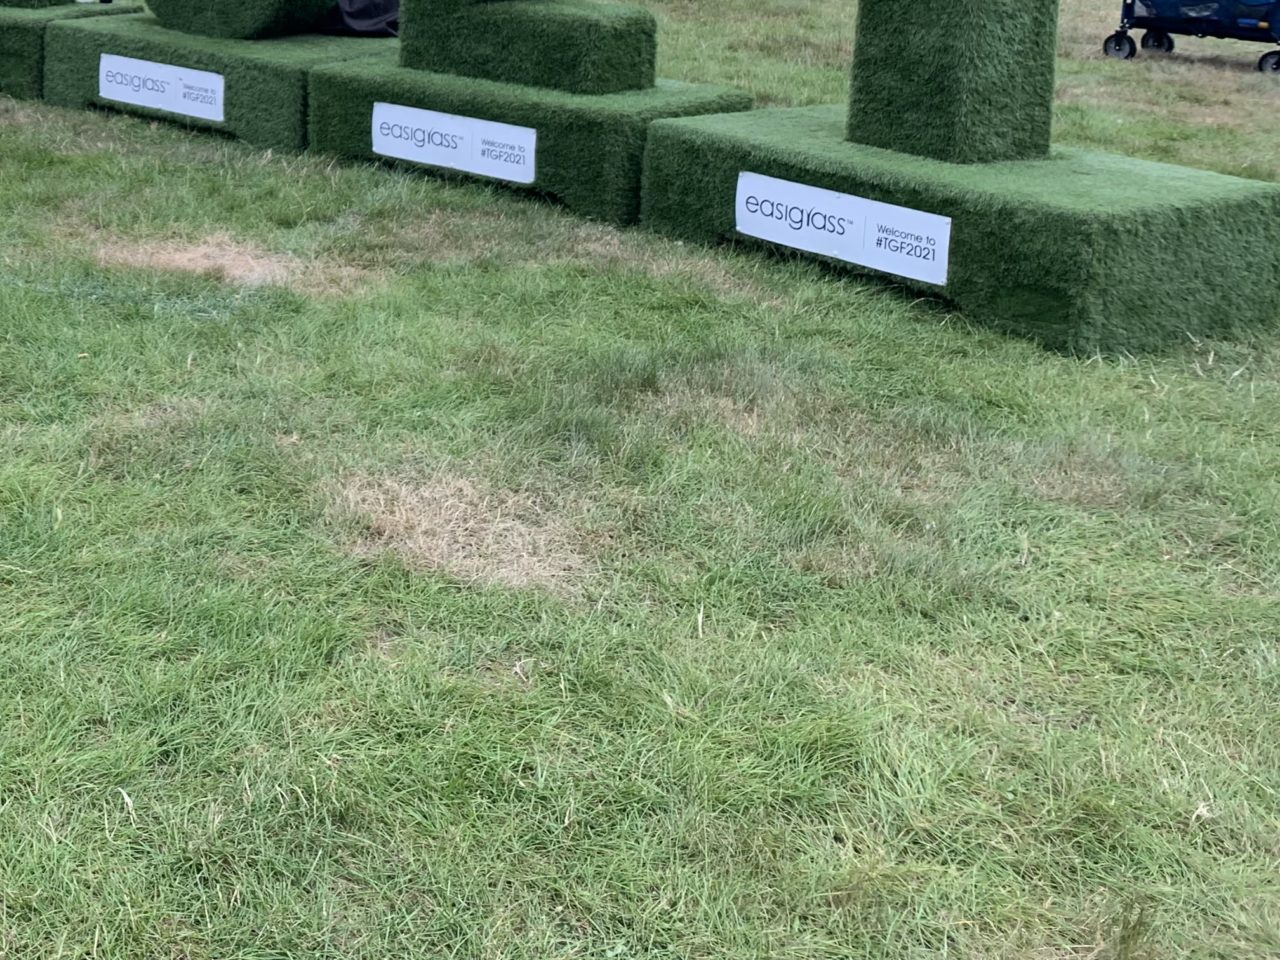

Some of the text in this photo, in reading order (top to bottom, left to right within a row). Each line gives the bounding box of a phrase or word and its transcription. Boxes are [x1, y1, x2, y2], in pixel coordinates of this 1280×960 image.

[481, 137, 526, 153] Welcome to
[481, 148, 526, 165] #TGF2021
[877, 223, 936, 246] Welcome to
[876, 236, 936, 261] #TGF2021
